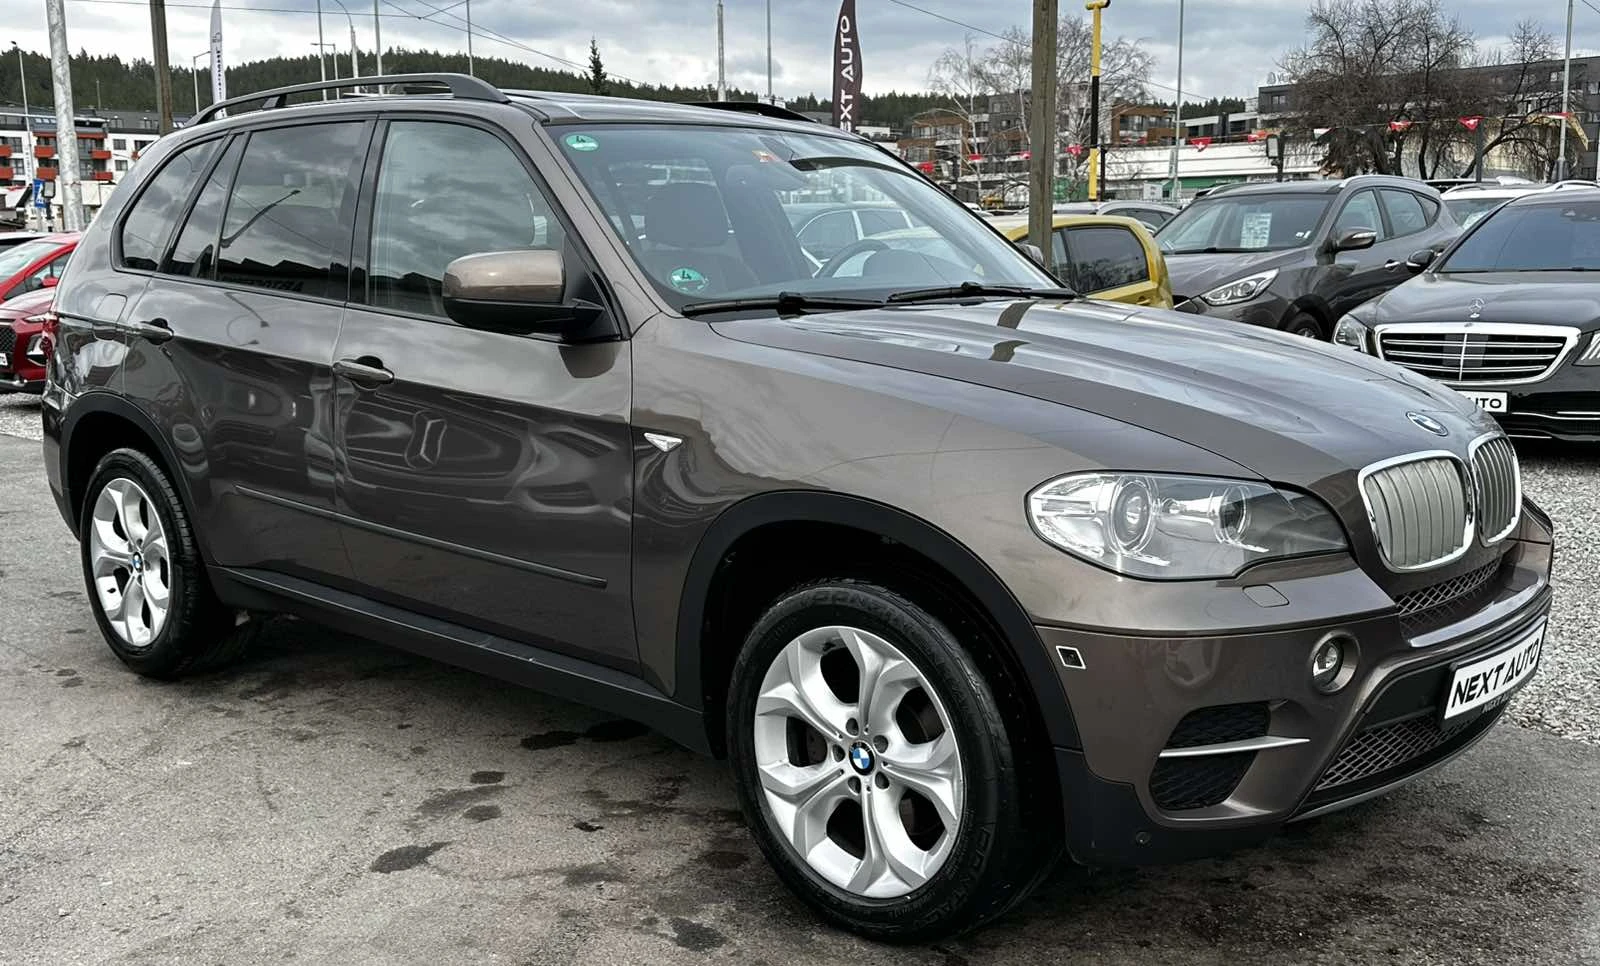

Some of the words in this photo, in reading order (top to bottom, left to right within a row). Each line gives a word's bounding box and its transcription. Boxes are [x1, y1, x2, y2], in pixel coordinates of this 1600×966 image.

[840, 15, 854, 83] AUTO
[840, 89, 854, 132] EXT
[1451, 661, 1506, 708] NEXT
[1502, 637, 1540, 685] AUTO
